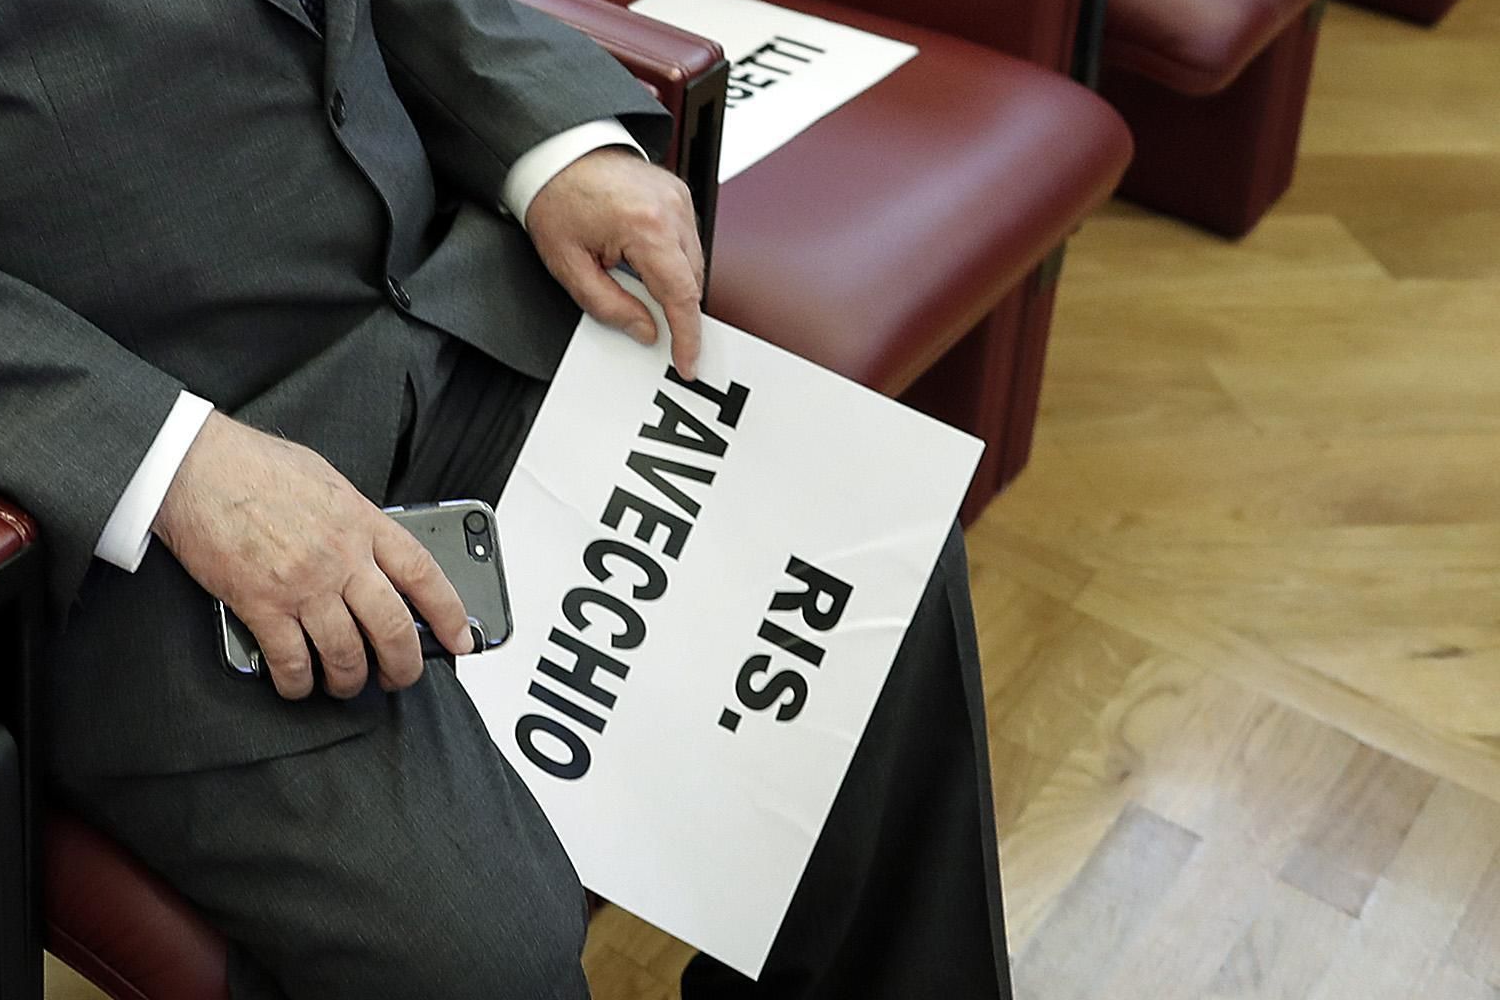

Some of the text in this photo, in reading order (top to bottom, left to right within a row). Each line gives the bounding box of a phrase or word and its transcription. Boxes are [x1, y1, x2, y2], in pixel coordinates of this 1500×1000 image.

[724, 34, 825, 110] GETTI
[513, 363, 752, 782] TAVECCHIO
[717, 554, 855, 734] RIS.
